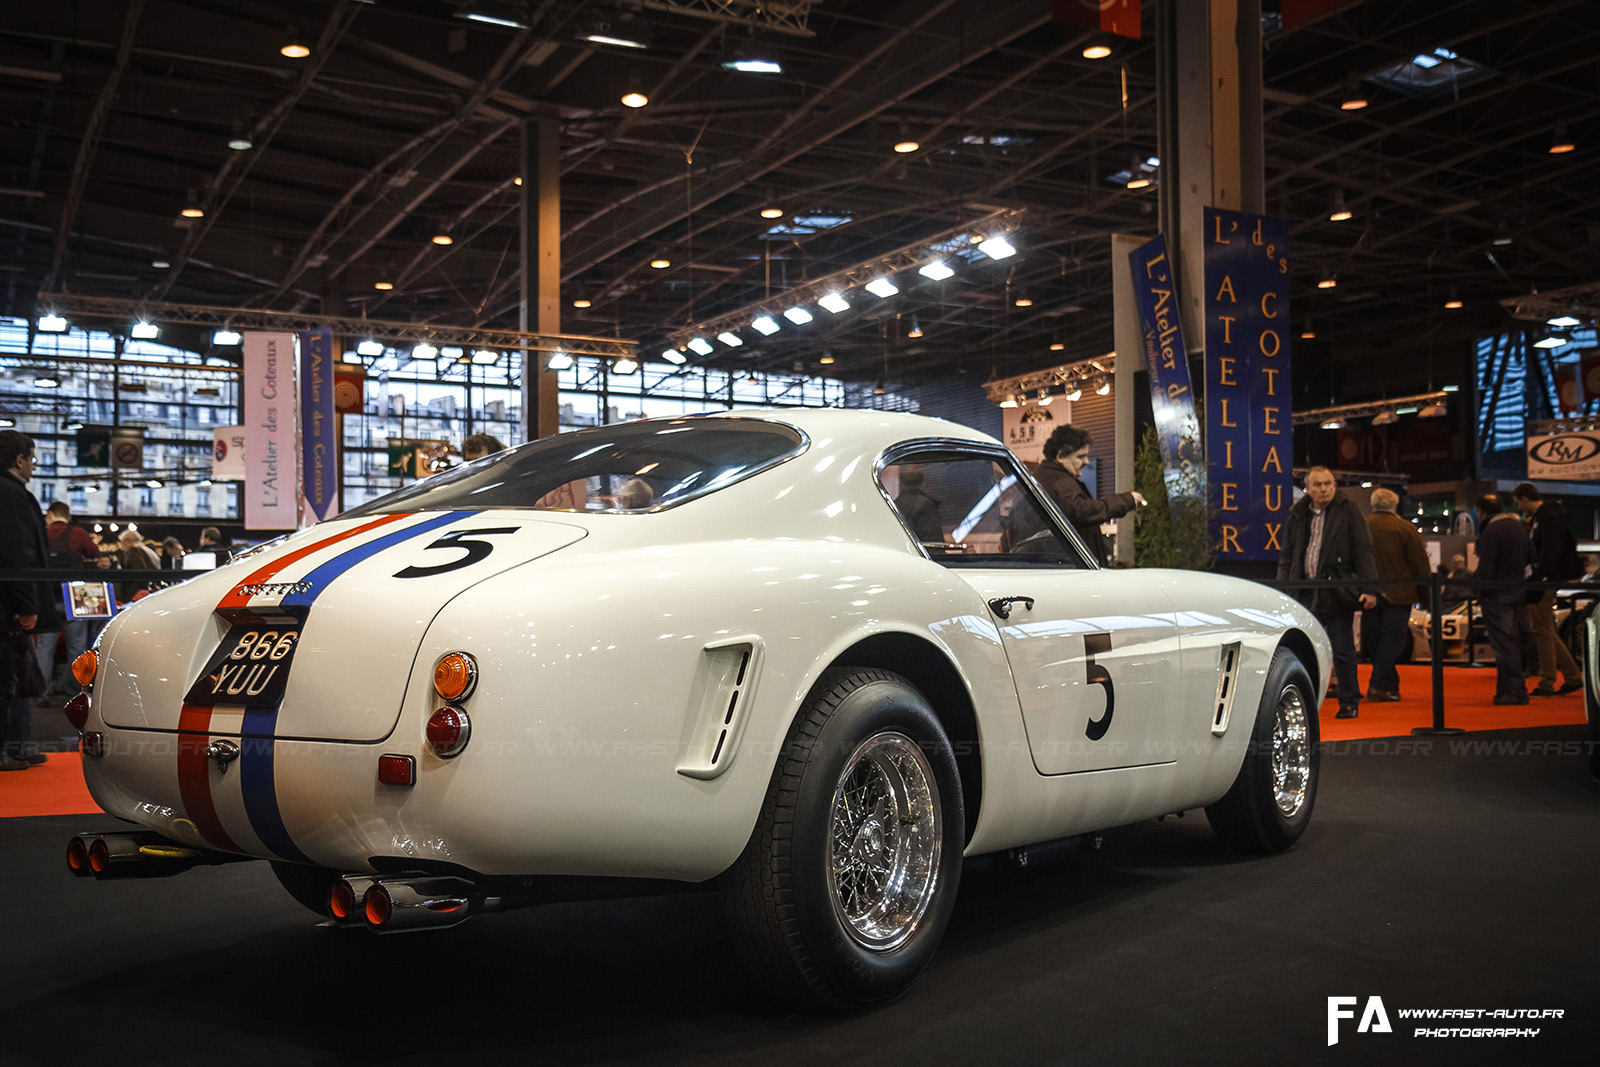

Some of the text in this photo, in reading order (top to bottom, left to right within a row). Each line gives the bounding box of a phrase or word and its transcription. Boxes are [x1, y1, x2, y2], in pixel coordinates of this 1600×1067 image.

[1145, 252, 1177, 370] L'Atelier
[261, 339, 278, 508] L'Atelier des Coteaux
[309, 334, 327, 506] L'Atelier des Coteaux
[1252, 219, 1288, 551] des COTEAUX
[1545, 440, 1586, 461] RM
[392, 526, 523, 579] 5
[211, 664, 280, 696] YUU
[231, 631, 299, 661] 866
[1084, 632, 1115, 741] 5
